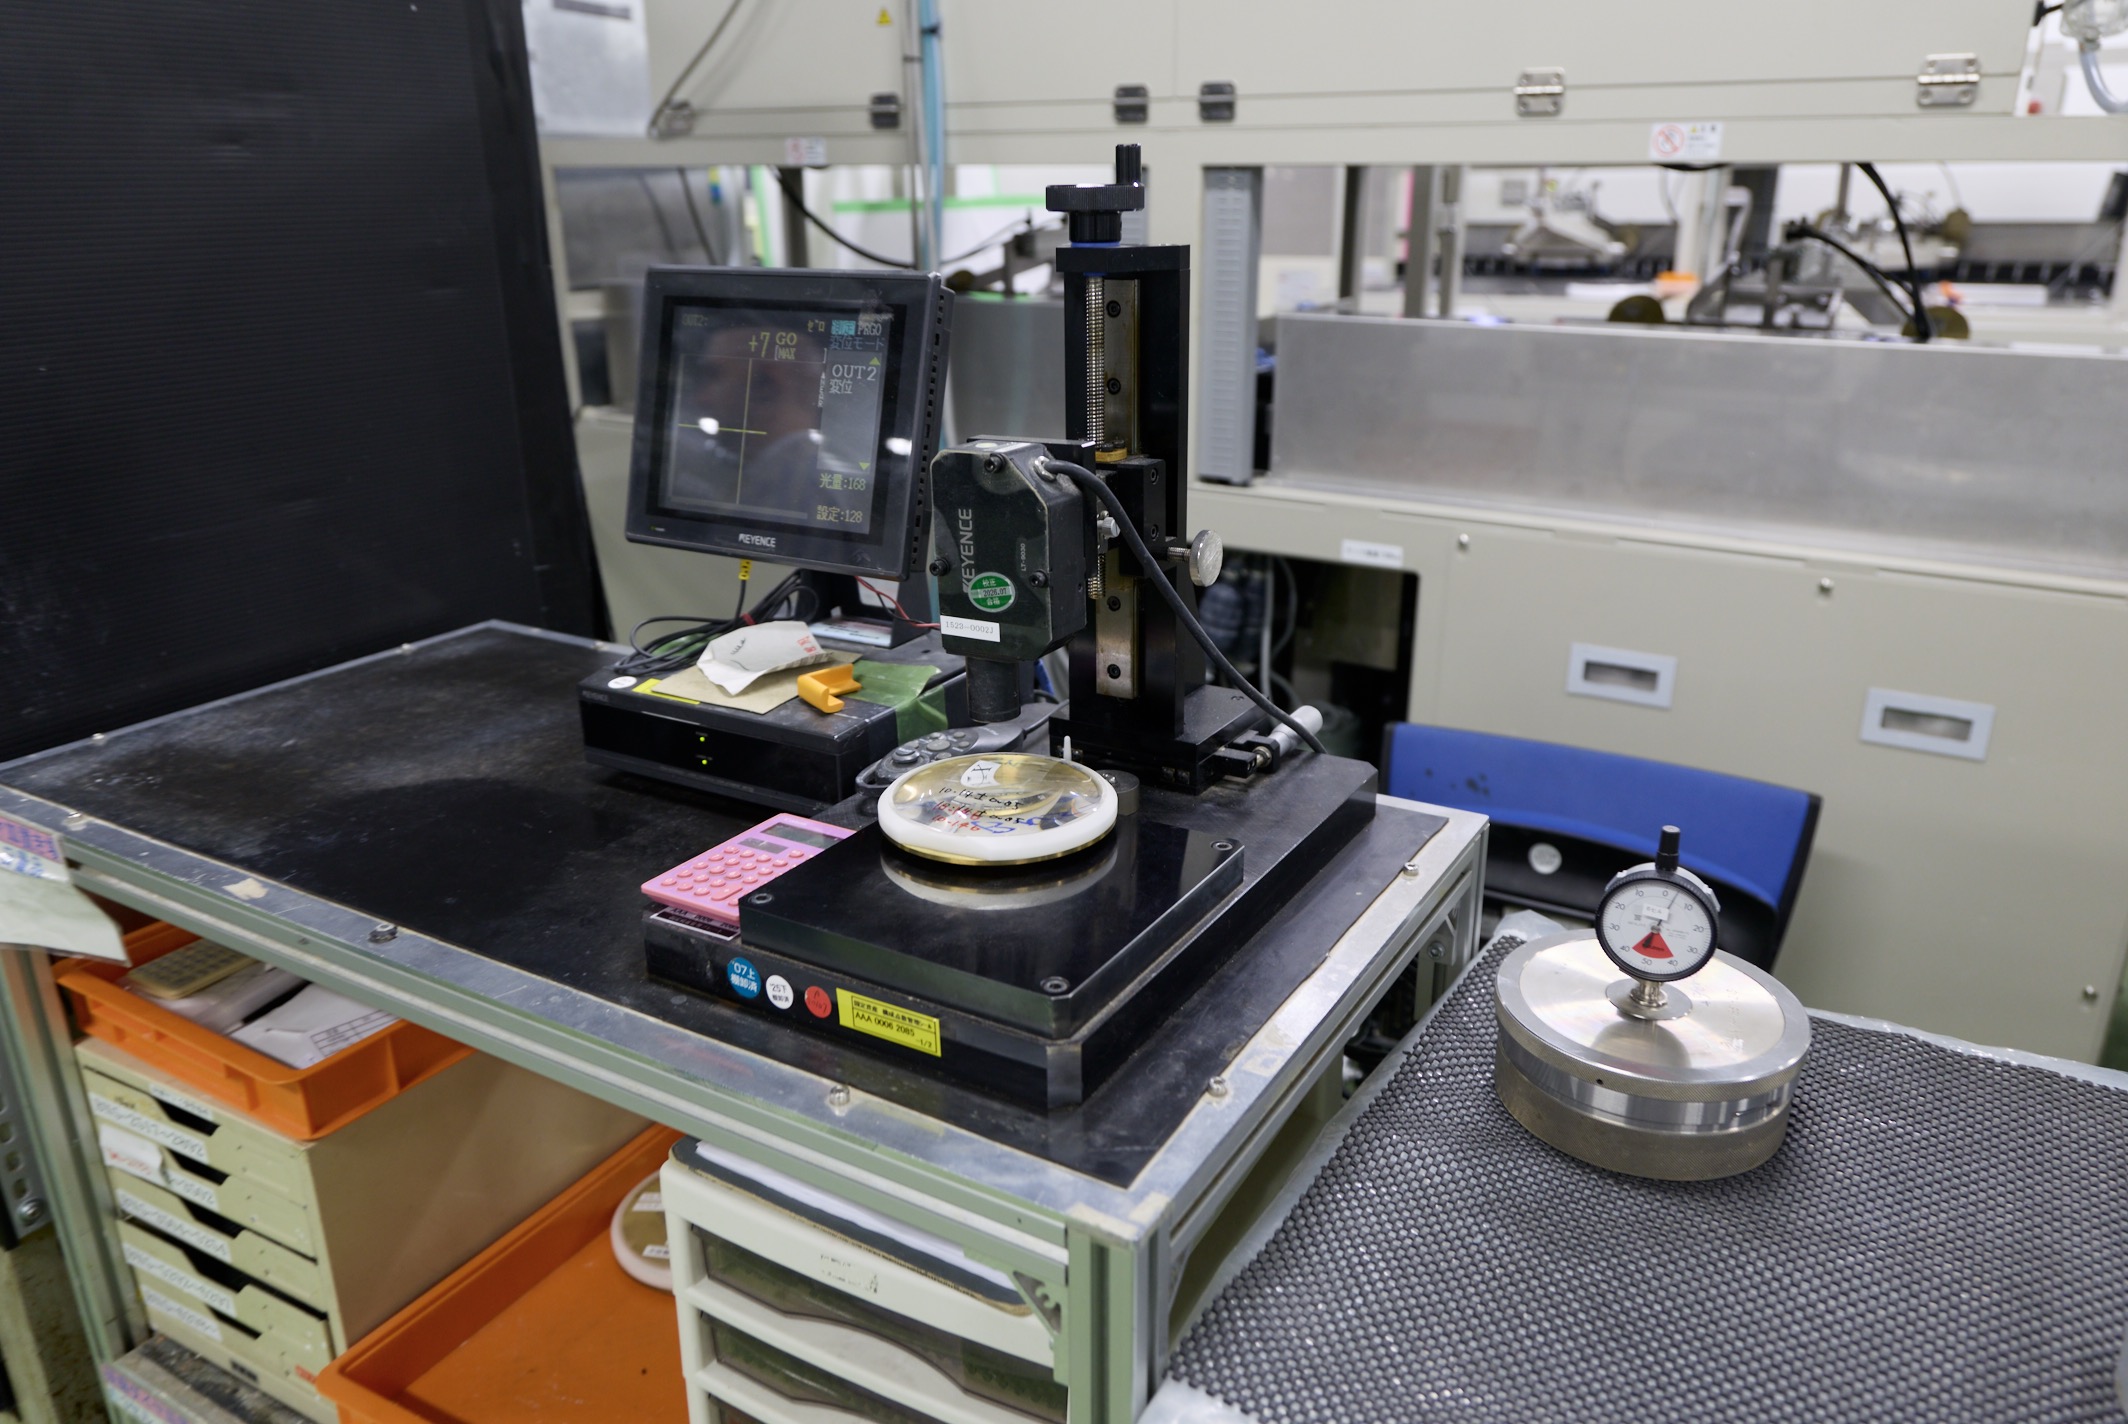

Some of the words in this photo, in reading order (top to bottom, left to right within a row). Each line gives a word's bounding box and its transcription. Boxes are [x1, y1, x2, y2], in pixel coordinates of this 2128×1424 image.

[775, 332, 798, 345] GO
[829, 379, 853, 395] 変位
[738, 533, 776, 548] KEYENCE
[1635, 889, 1644, 898] 10
[1662, 890, 1669, 898] 0
[1615, 902, 1625, 910] 20
[1684, 903, 1693, 911] 10
[1610, 923, 1620, 931] 30
[1693, 925, 1704, 933] 20
[1620, 943, 1630, 952] 40
[1687, 946, 1698, 954] 30
[1642, 957, 1653, 966] 50
[1668, 959, 1678, 967] 40
[855, 1012, 873, 1024] AAA
